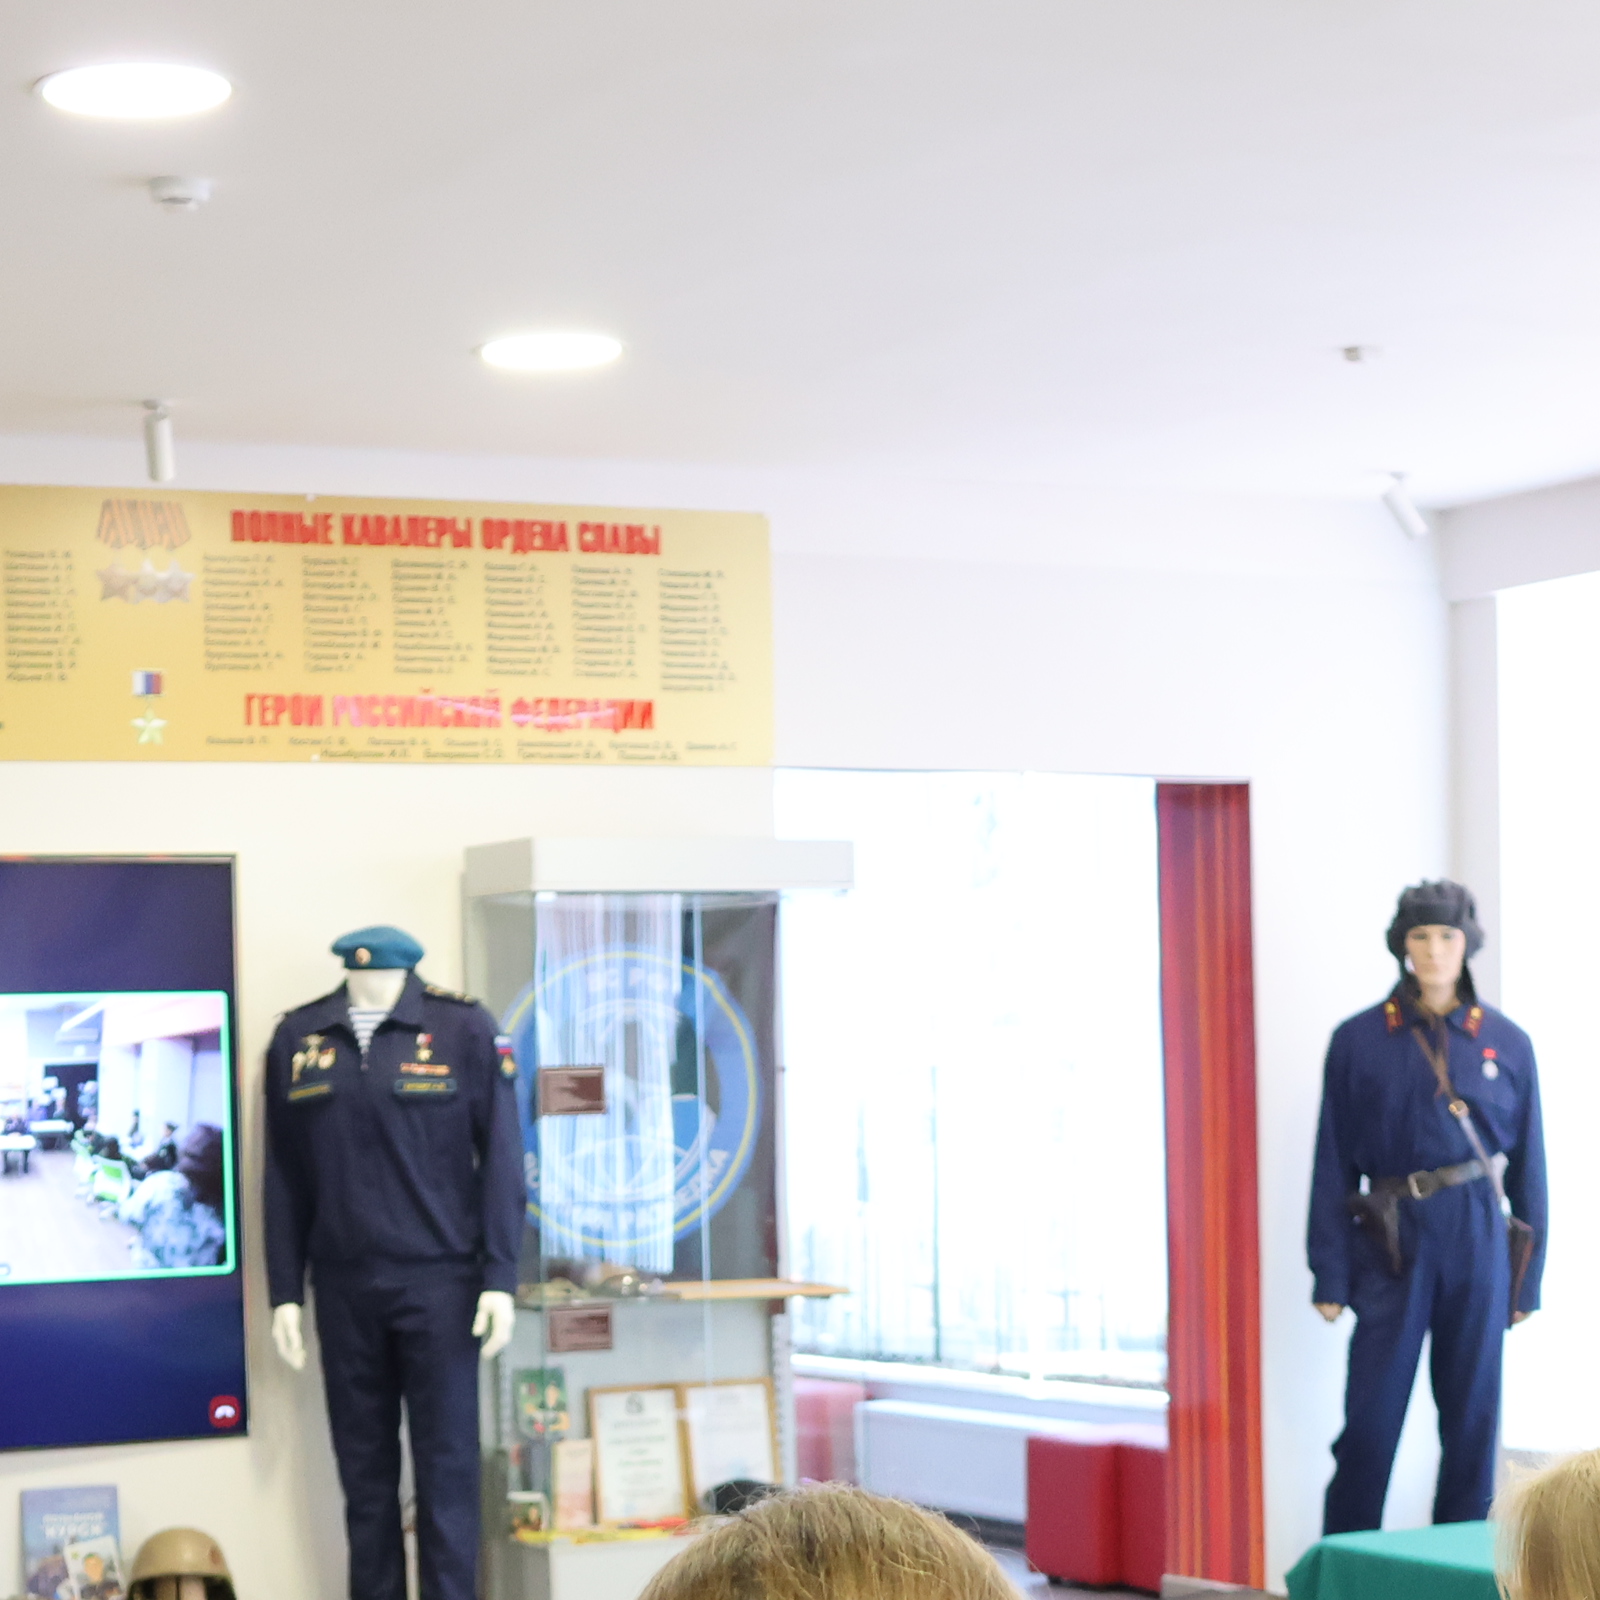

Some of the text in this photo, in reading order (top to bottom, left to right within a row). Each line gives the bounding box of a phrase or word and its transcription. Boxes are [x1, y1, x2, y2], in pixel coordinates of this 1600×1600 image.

[231, 509, 661, 555] ПОЛНЫЕ КАВАЛЕРЫ ОРДЕНА СЛАВЫ
[244, 687, 654, 733] ГЕРОИ РОССИЙСКОЙ ФЕДЕРАЦИИ
